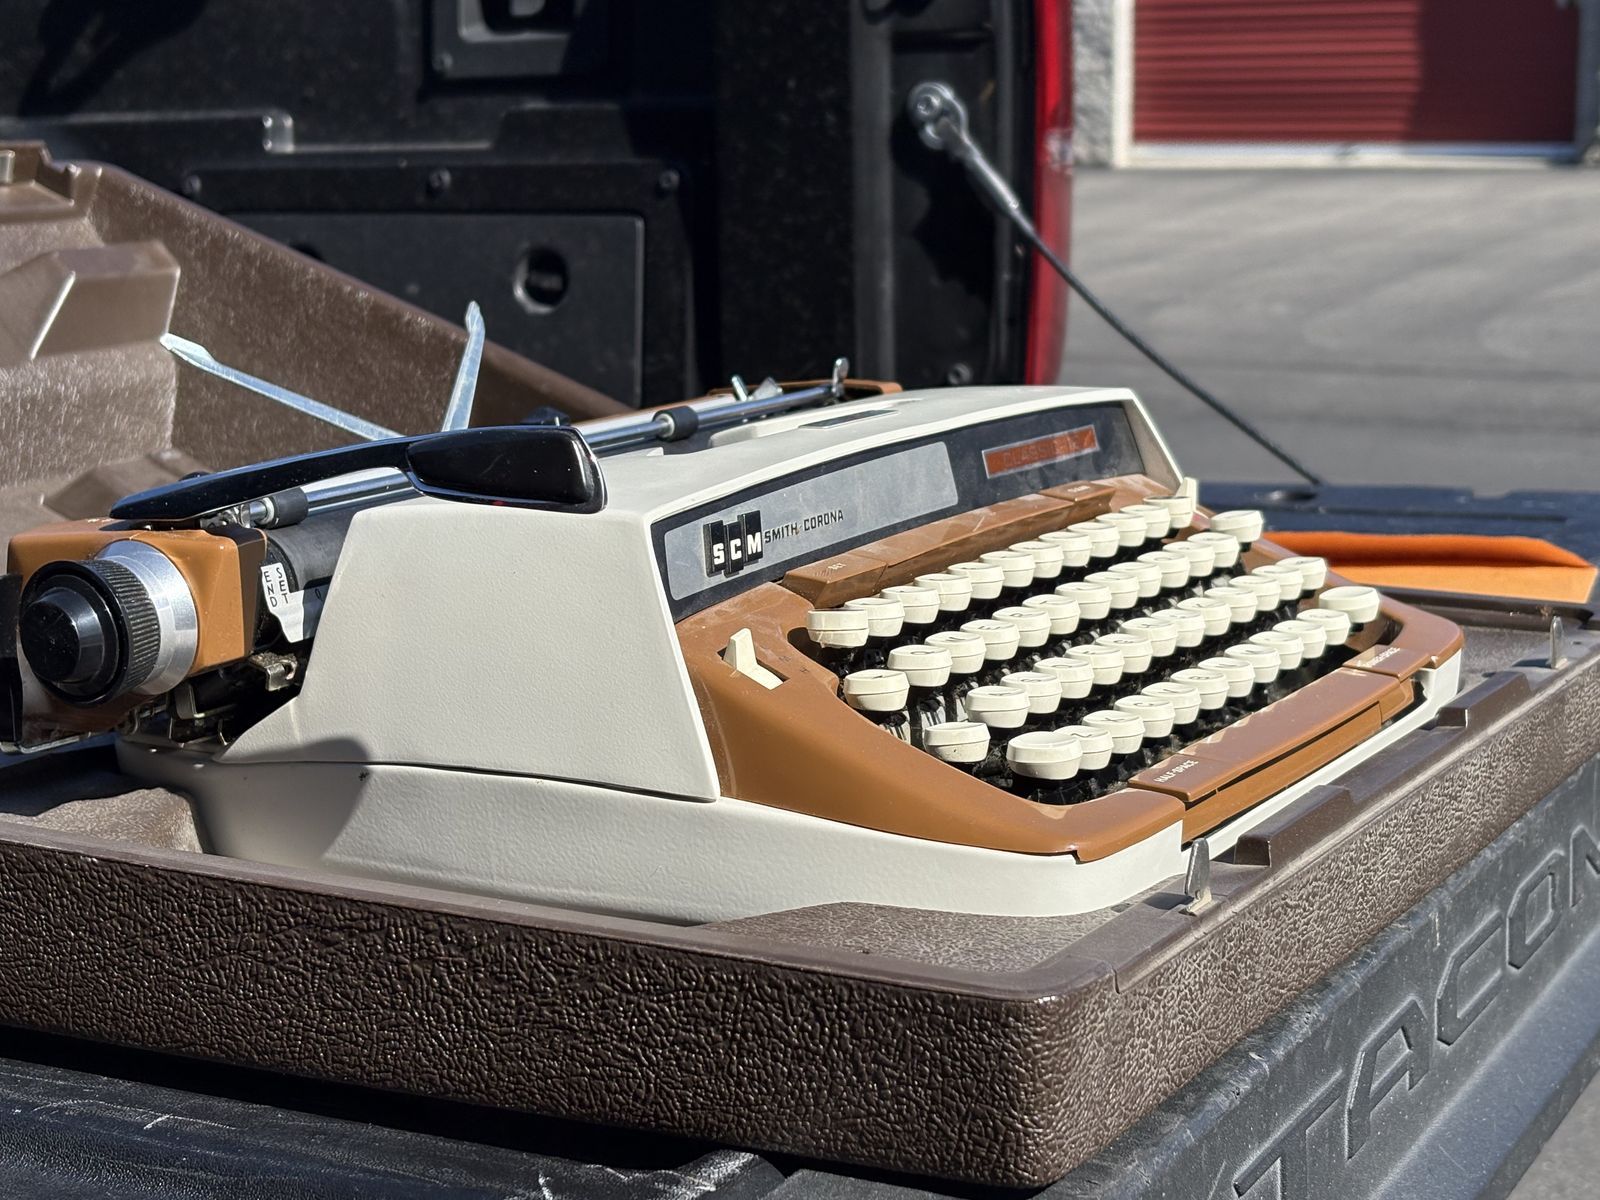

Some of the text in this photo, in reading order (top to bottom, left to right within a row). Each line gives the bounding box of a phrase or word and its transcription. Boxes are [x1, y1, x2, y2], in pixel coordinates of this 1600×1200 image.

[712, 532, 763, 566] SCM
[264, 571, 279, 608] END
[276, 567, 289, 605] SET
